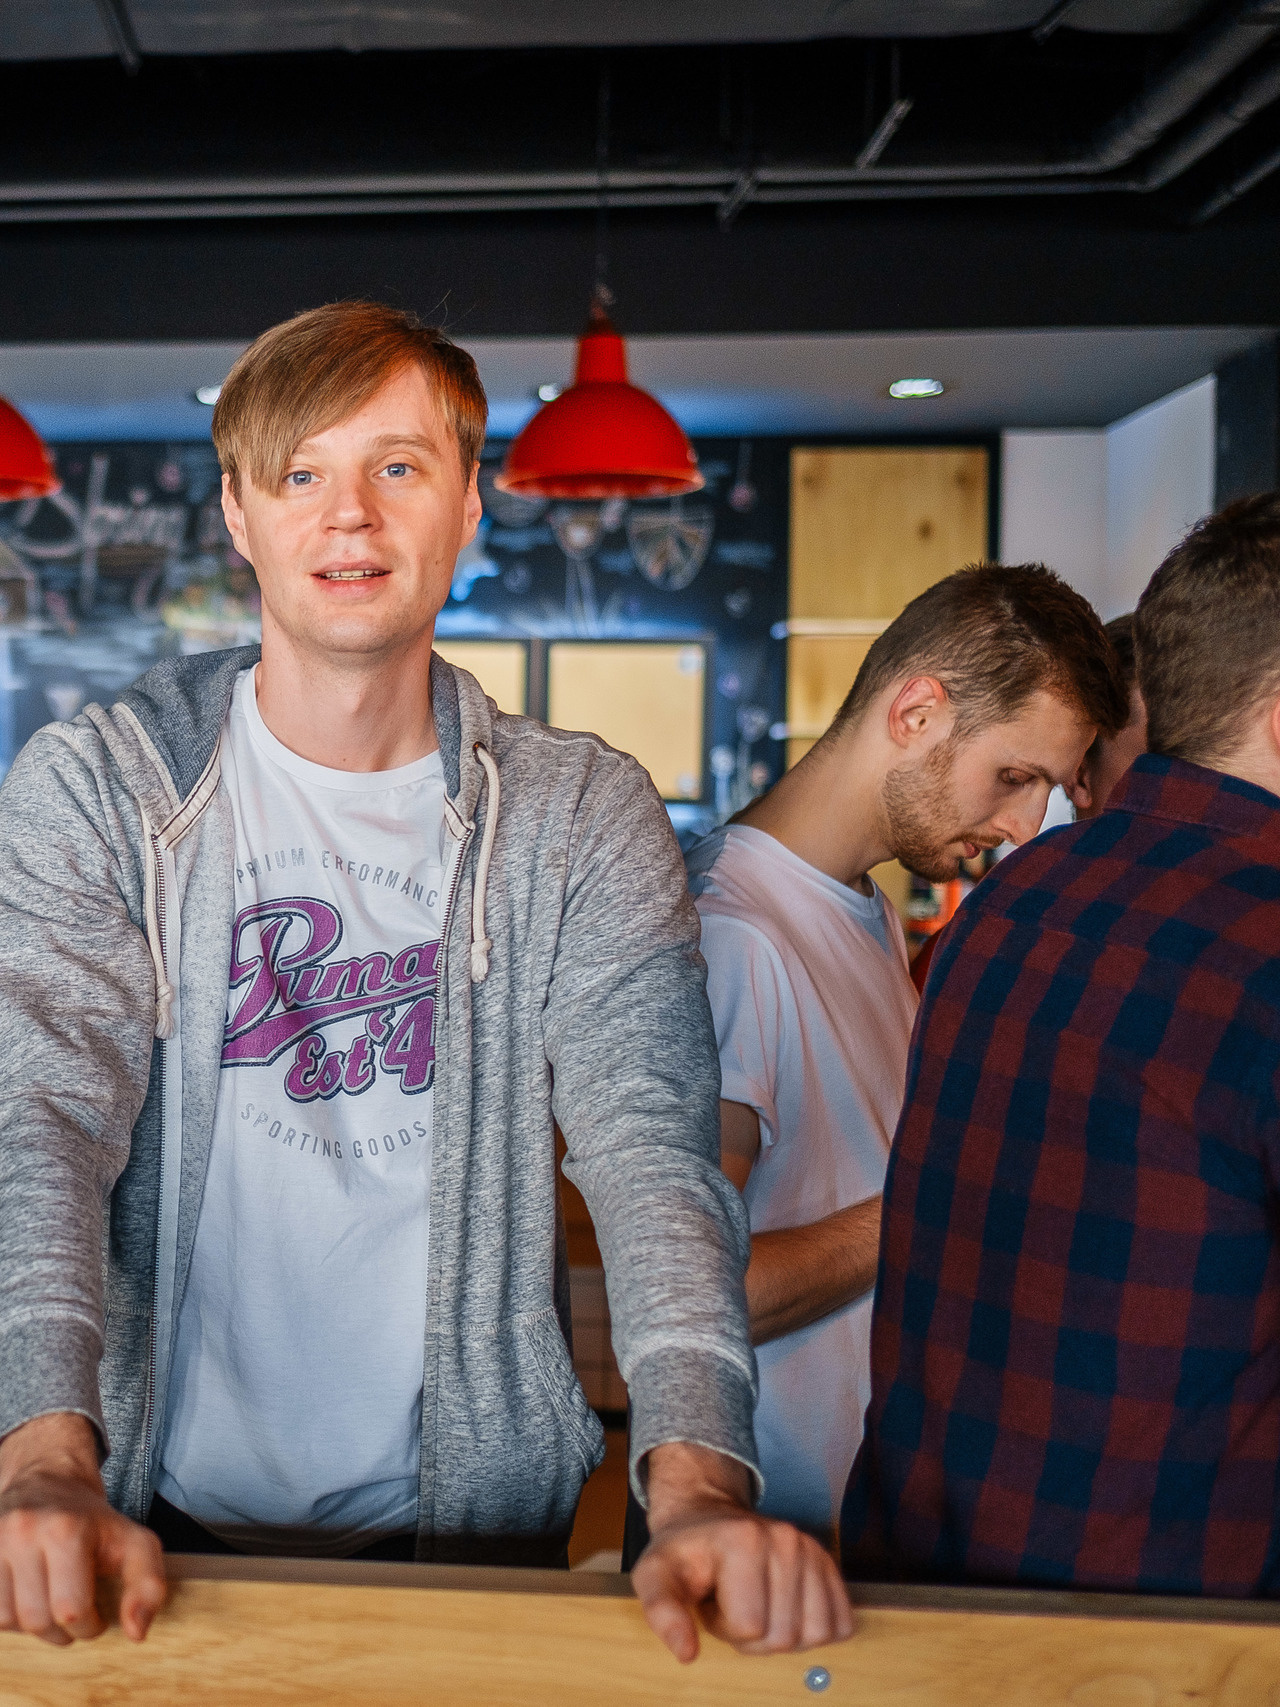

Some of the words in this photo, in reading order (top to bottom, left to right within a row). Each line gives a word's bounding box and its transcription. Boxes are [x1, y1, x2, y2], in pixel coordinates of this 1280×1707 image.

[223, 896, 441, 1043] Puma
[241, 1103, 343, 1159] SPORTING
[353, 1120, 427, 1159] GOODS
